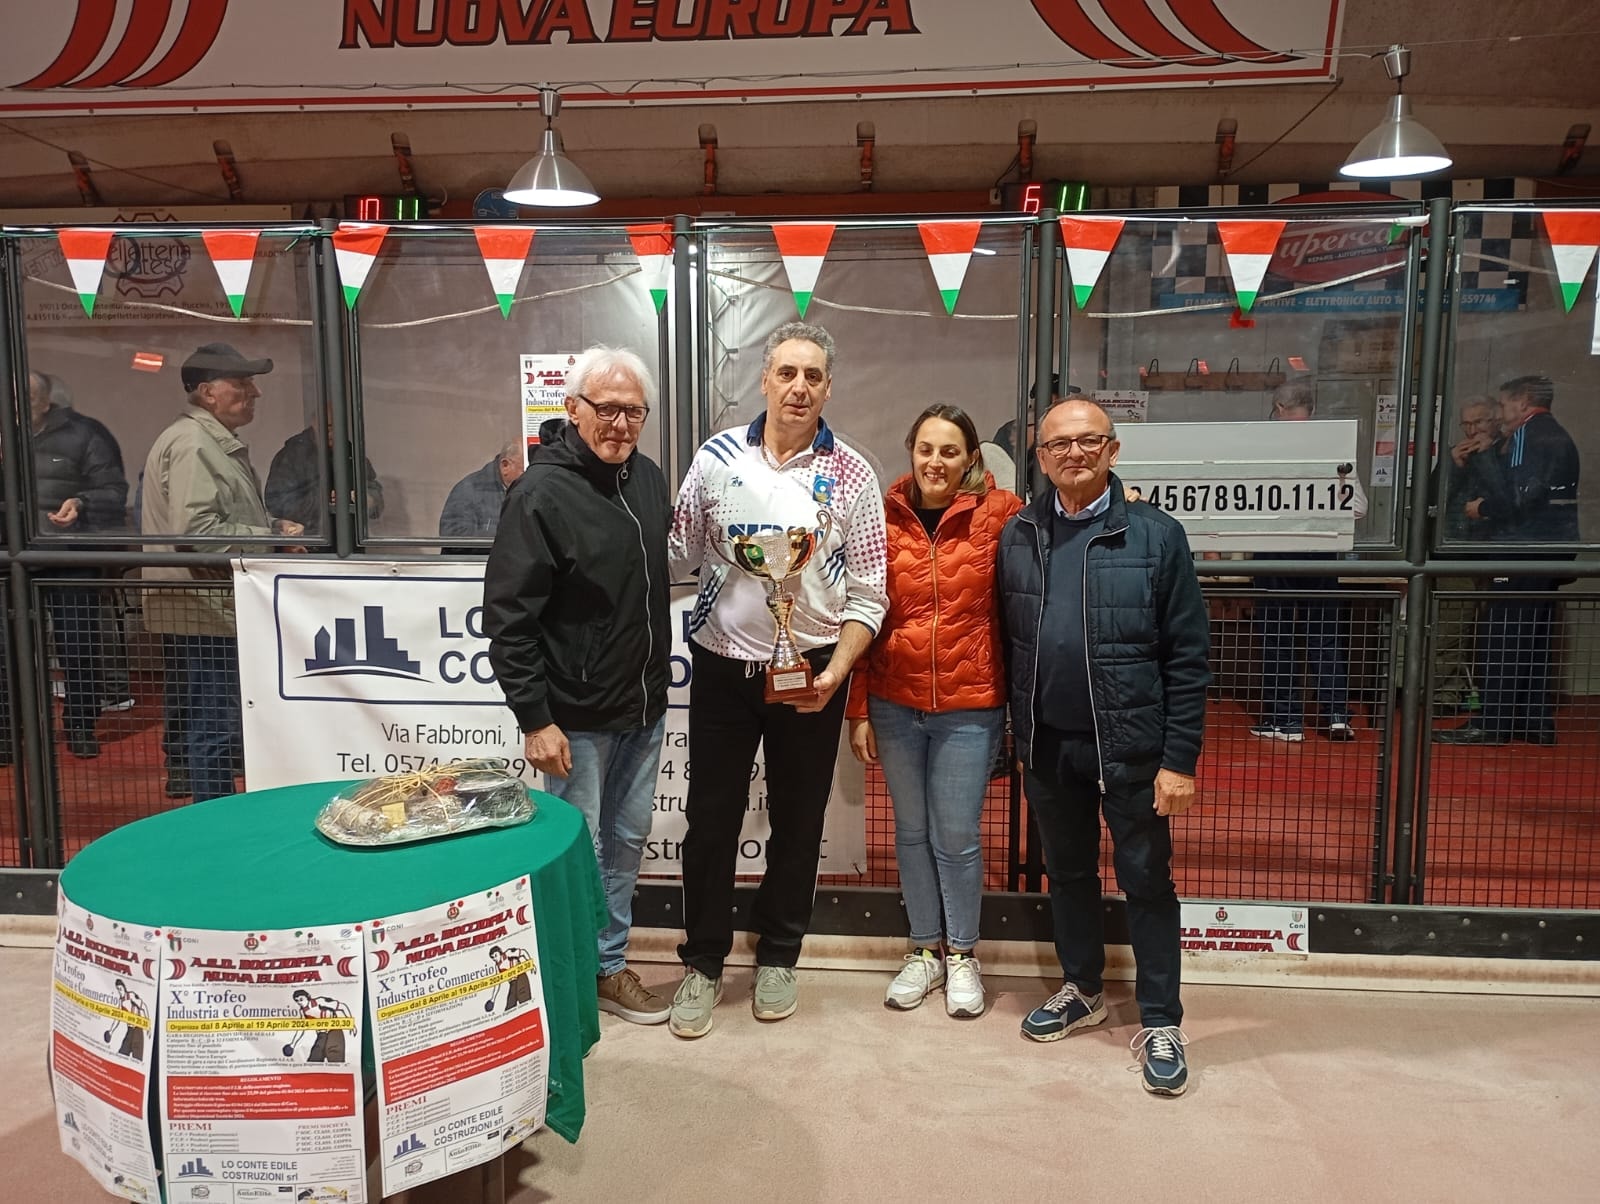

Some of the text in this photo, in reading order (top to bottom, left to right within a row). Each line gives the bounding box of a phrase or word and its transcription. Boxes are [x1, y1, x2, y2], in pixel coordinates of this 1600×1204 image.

[338, 0, 922, 48] NUOVA EUROPA
[381, 722, 410, 744] Via
[416, 724, 506, 747] Fabbroni,
[336, 752, 376, 772] Tel.
[386, 923, 404, 932] CONI
[440, 908, 514, 942] BOCCIOFILA
[1205, 928, 1284, 940] BOCCIOFILA
[406, 942, 454, 966] NUOVA
[456, 925, 508, 950] EUROPA
[1219, 941, 1274, 952] EUROPA
[63, 959, 86, 981] Trofeo
[238, 954, 333, 970] BOCCIOFILA
[202, 970, 322, 983] NUOVA EUROPA
[376, 964, 494, 1008] Industria e Commercio
[400, 966, 448, 987] Trofeo
[78, 982, 118, 1006] Commercio
[193, 989, 247, 1004] Trofeo
[410, 1000, 421, 1009] dal
[428, 992, 449, 1005] Aprile
[459, 987, 468, 995] 19
[468, 981, 488, 993] Aprile
[489, 975, 504, 985] 2024
[167, 1004, 298, 1019] Industria e Commercio
[200, 1022, 213, 1030] dal
[222, 1020, 245, 1031] Aprile
[247, 1020, 254, 1028] al
[266, 1020, 290, 1030] Aprile
[291, 1020, 309, 1028] 2024
[386, 1095, 427, 1116] PREMI
[434, 1105, 503, 1136] LO CONTE EDILE
[434, 1122, 492, 1146] COSTRUZIONI
[494, 1116, 504, 1128] srl
[222, 1160, 297, 1170] LO CONTE EDILE
[222, 1171, 298, 1181] COSTRUZIONI srl
